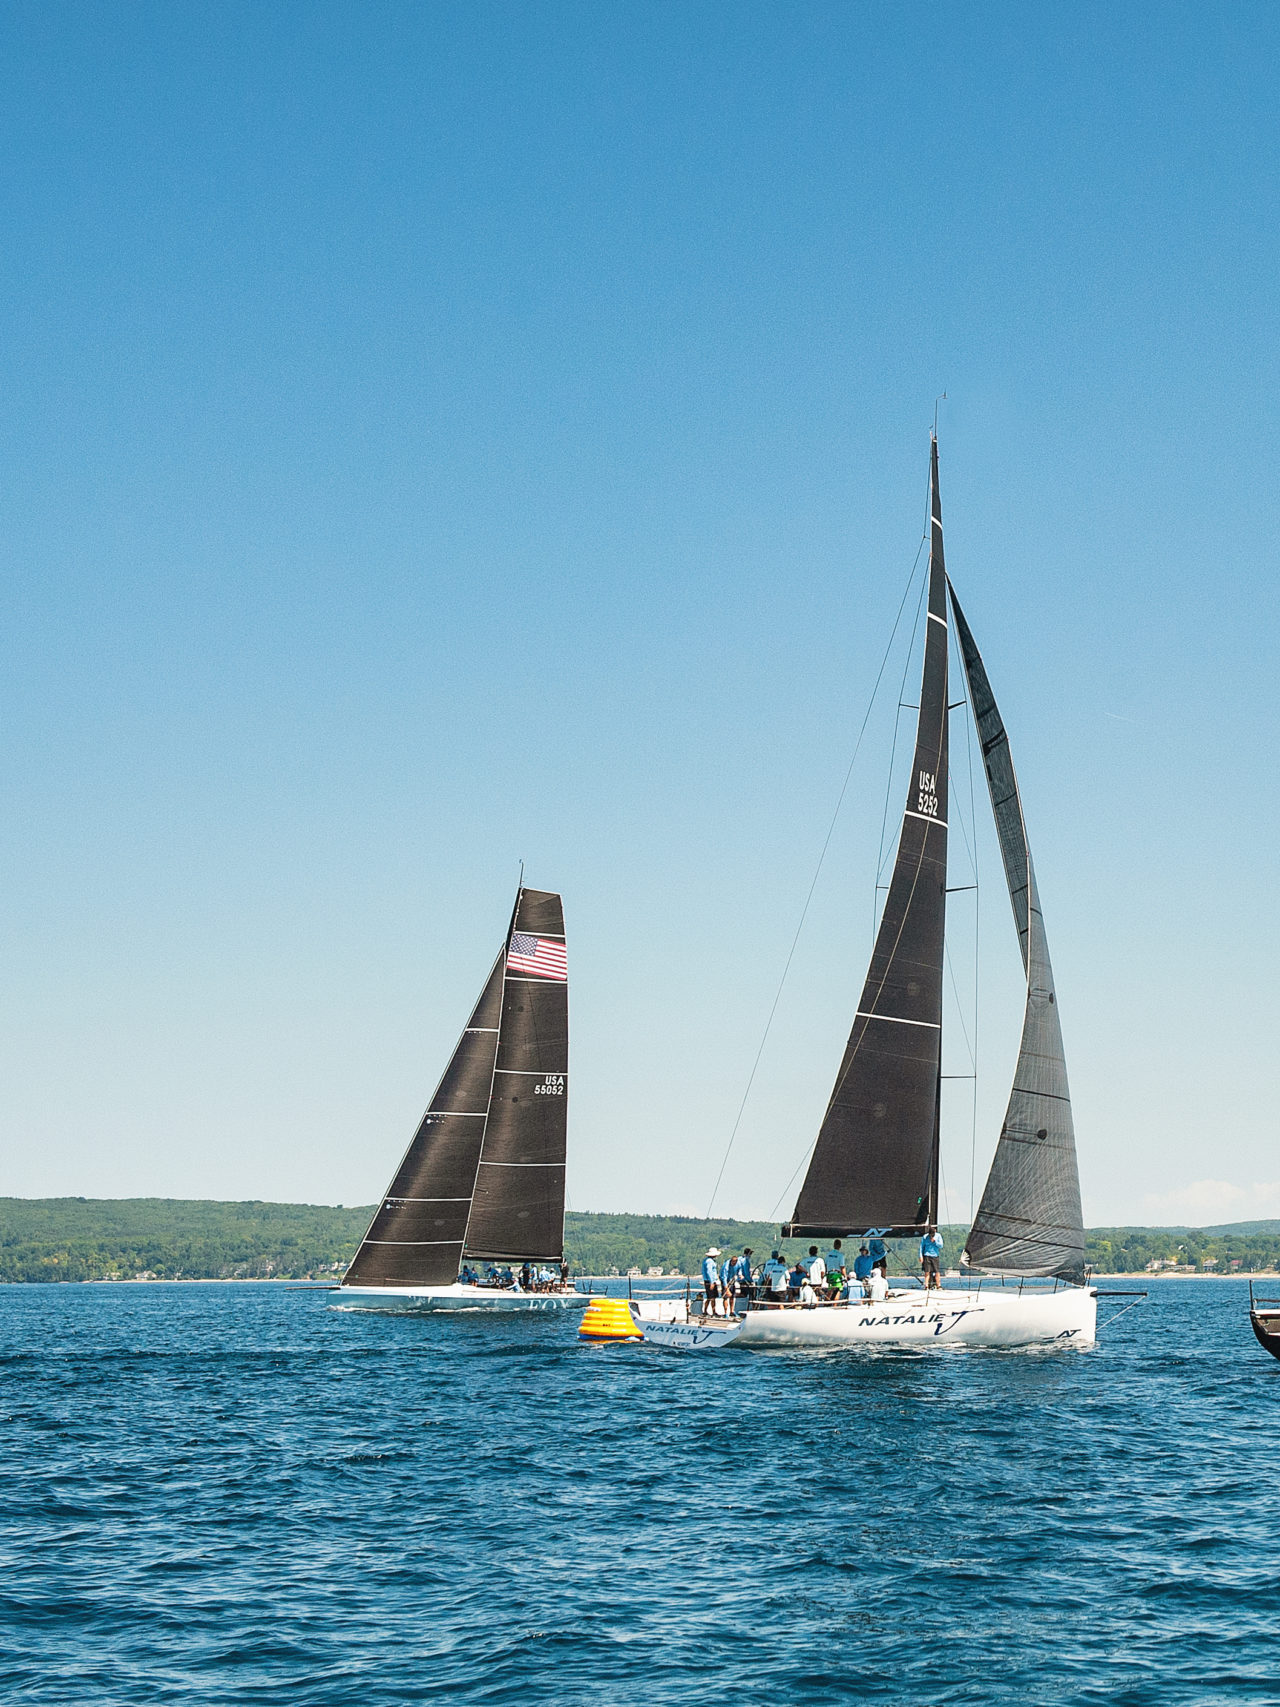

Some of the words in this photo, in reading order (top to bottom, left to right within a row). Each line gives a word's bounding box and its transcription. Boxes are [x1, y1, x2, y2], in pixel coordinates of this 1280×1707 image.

[919, 770, 935, 794] USA
[917, 792, 938, 816] 5252
[545, 1075, 564, 1085] USA
[534, 1084, 564, 1095] 55052
[858, 1313, 946, 1326] NATALIE
[646, 1325, 699, 1336] NATALIE
